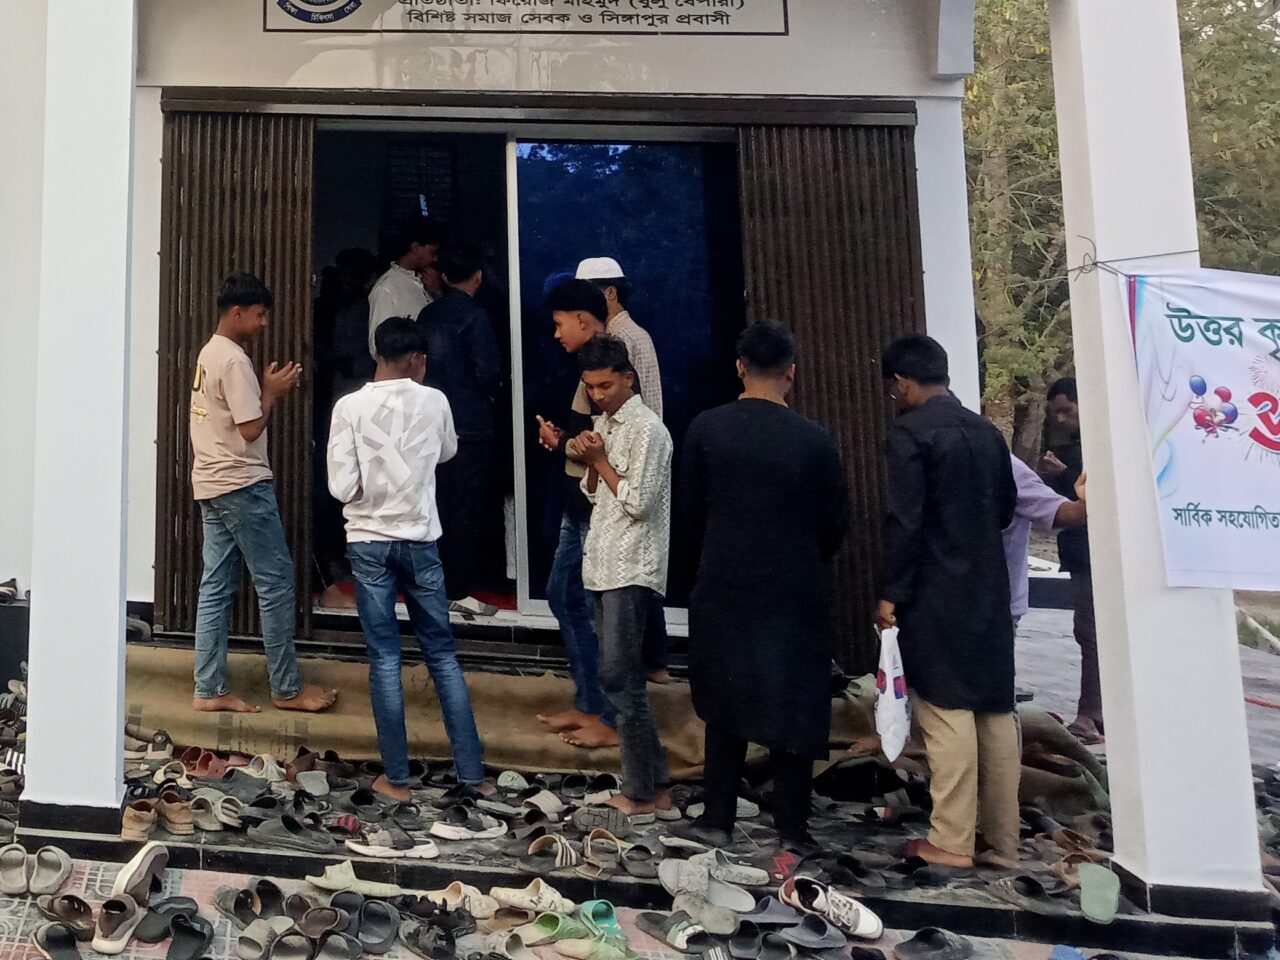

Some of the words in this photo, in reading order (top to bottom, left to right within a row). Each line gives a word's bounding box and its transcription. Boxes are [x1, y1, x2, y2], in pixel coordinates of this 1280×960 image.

[406, 10, 457, 24] বিশিষ্ট
[462, 12, 513, 25] সমাজ
[520, 11, 572, 25] সেবক
[577, 13, 593, 24] ও
[598, 10, 670, 27] সিঙ্গাপুর
[675, 10, 732, 26] প্রবাসী
[1163, 301, 1245, 348] উত্তর
[1171, 501, 1213, 528] সার্বিক
